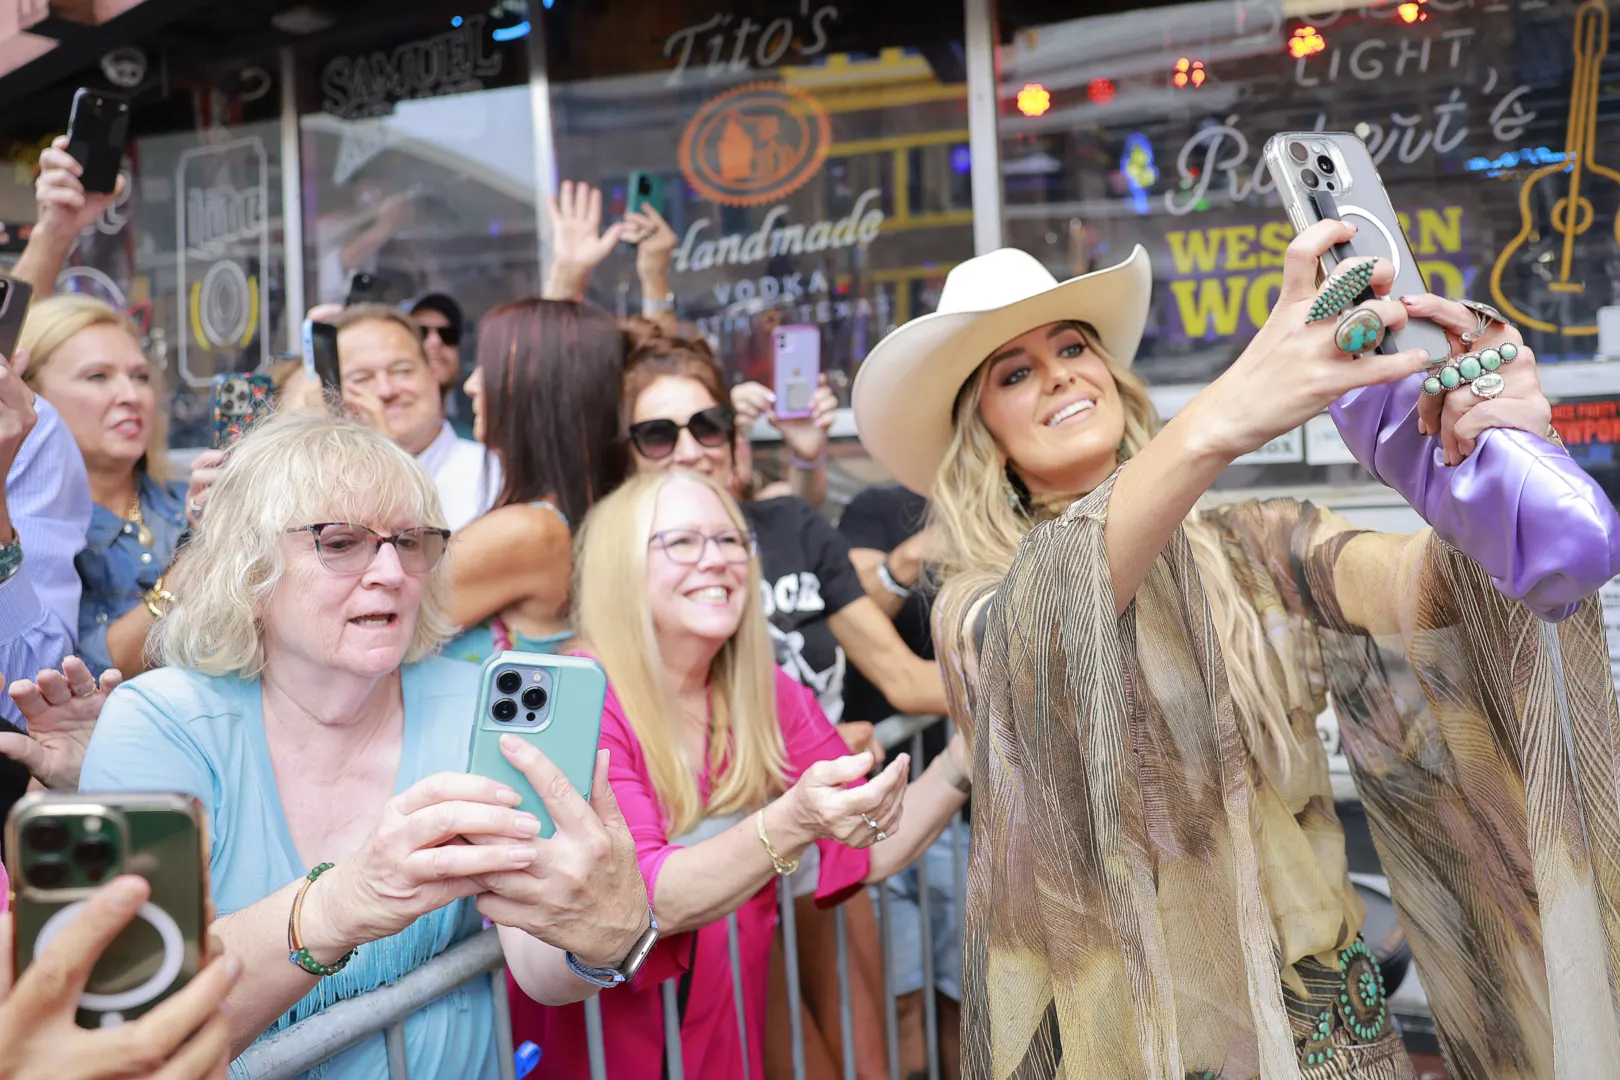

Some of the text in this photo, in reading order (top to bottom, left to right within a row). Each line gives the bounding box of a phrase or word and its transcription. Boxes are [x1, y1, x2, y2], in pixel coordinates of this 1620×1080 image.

[1294, 28, 1475, 87] LIGHT
[1165, 67, 1538, 216] Roert's
[1166, 206, 1464, 275] WESN
[713, 270, 829, 306] VODKA
[1170, 260, 1467, 338] WOD
